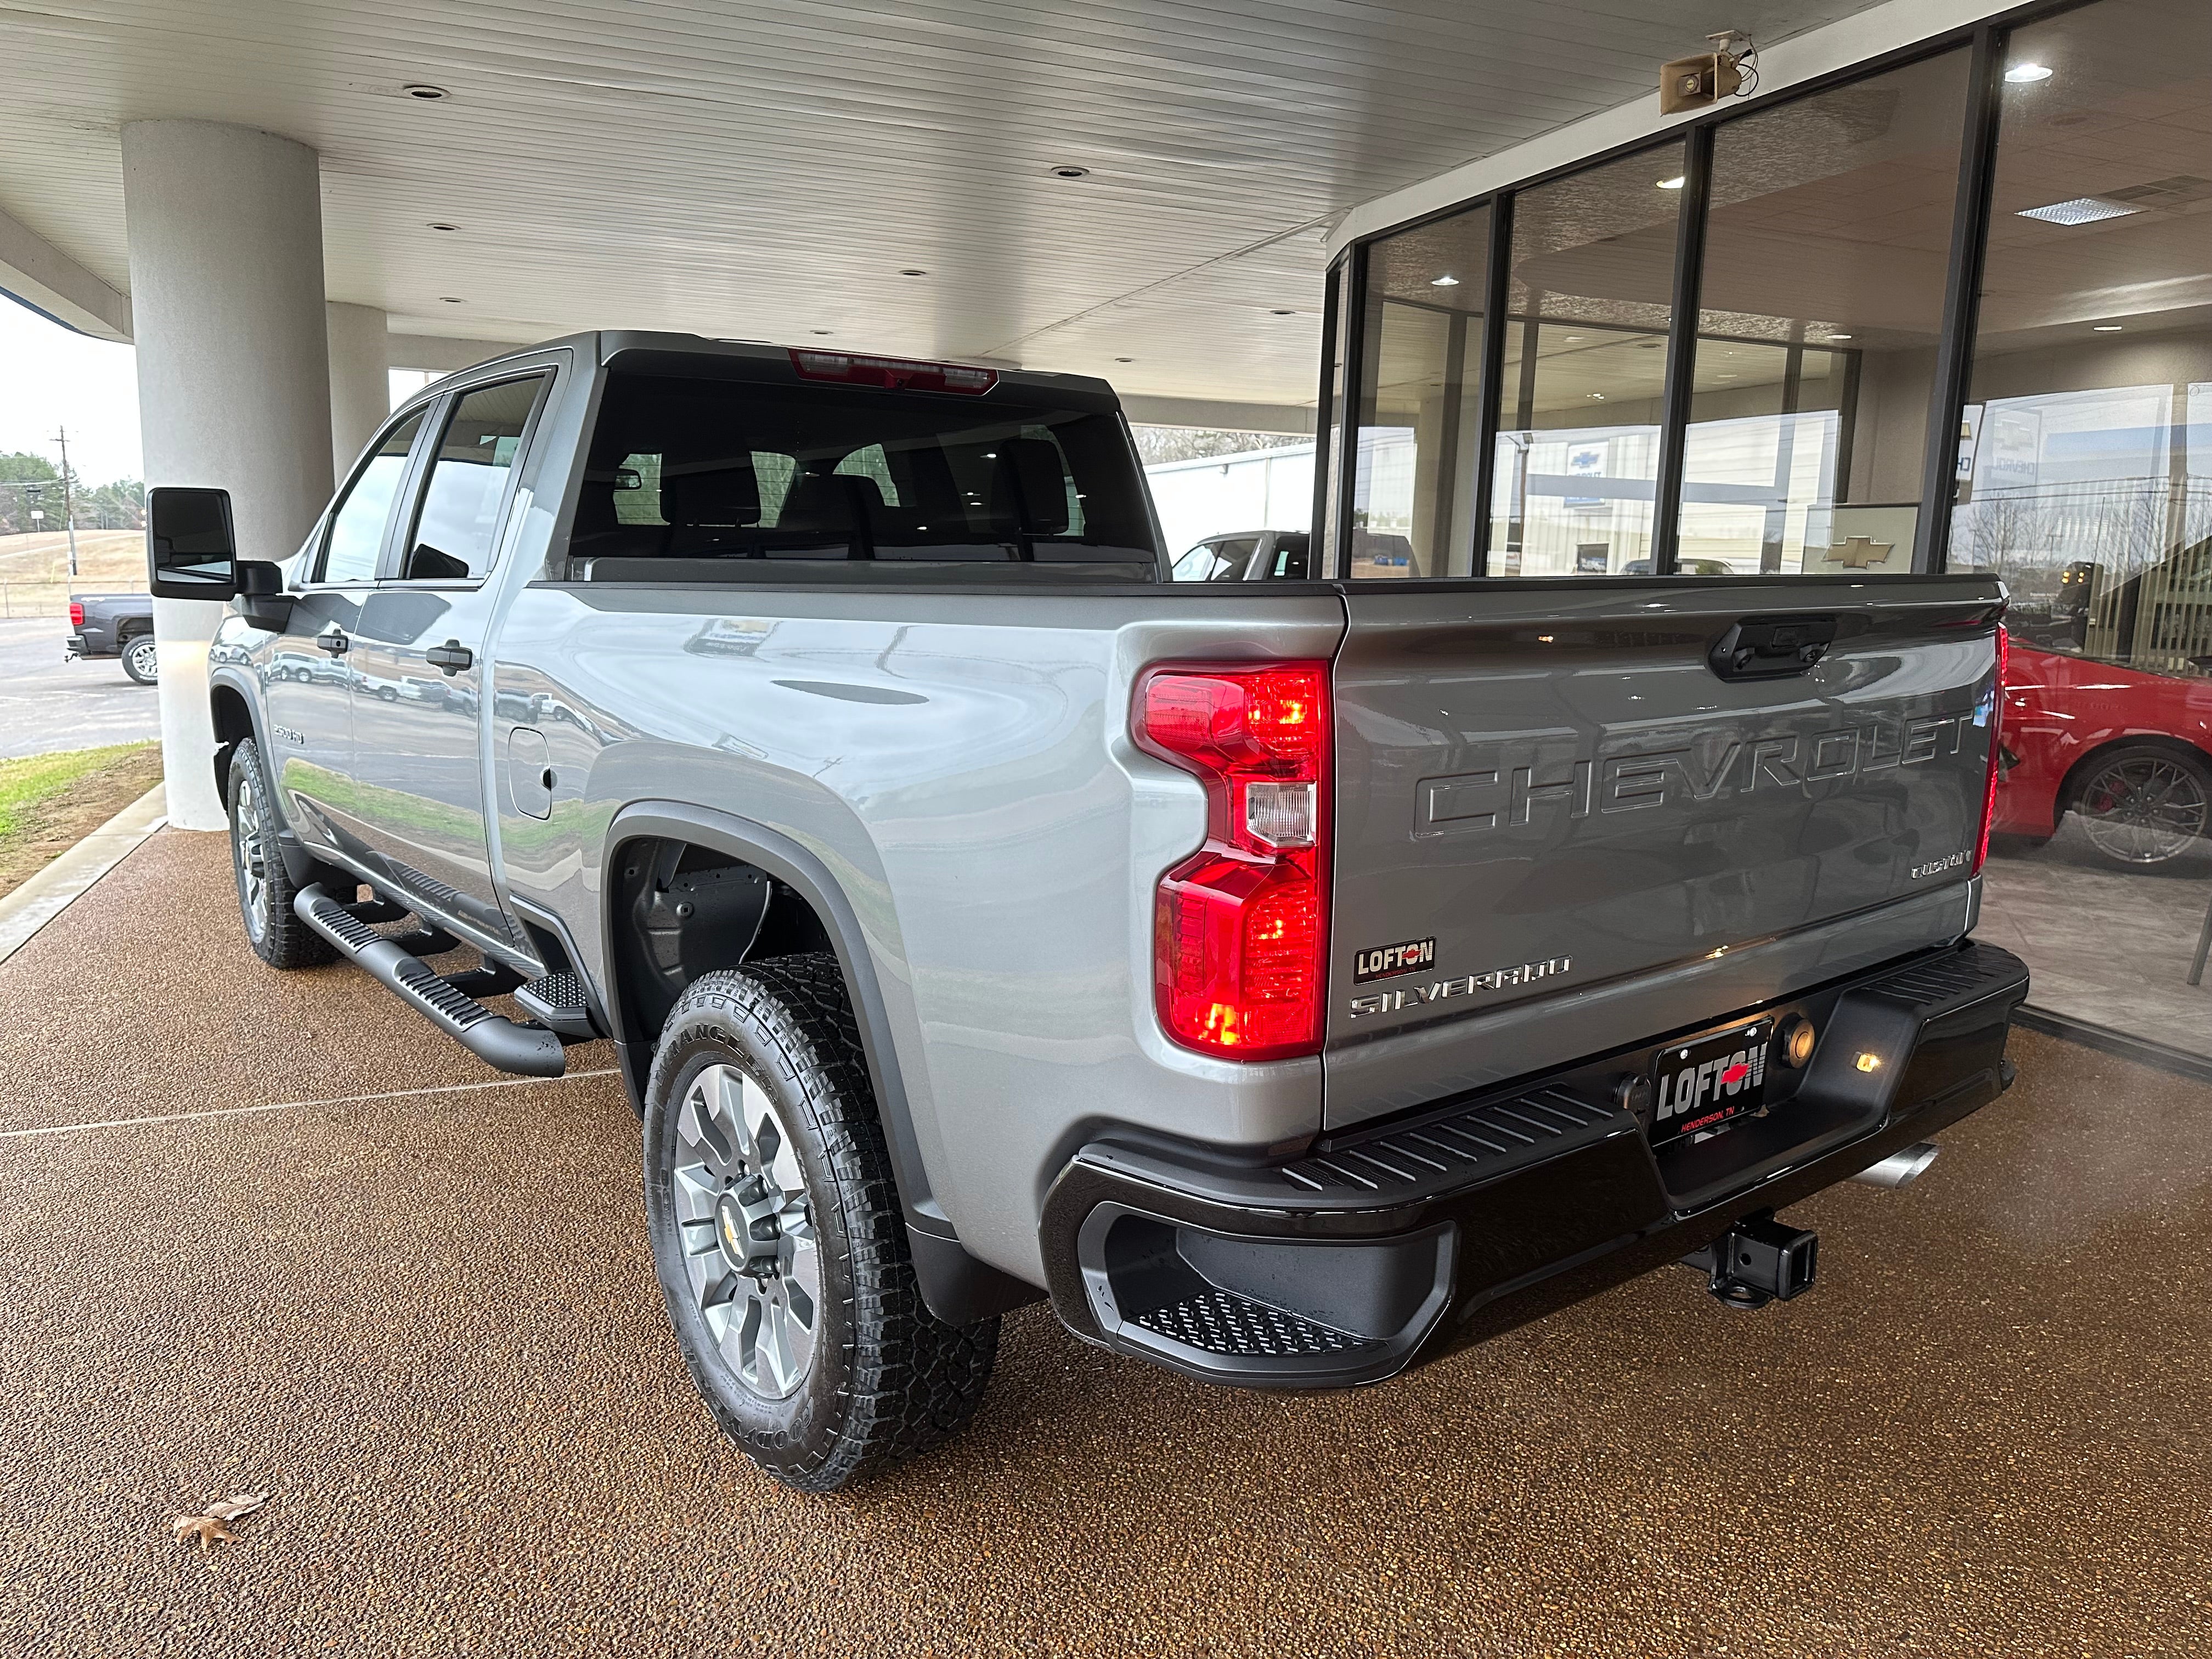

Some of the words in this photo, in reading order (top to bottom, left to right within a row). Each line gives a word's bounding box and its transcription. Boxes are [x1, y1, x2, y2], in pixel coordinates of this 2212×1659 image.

[1413, 708, 1973, 839] CHEVROLET
[1350, 955, 1573, 1019] SILVERADO
[1357, 940, 1434, 975] LOFTON
[656, 1024, 779, 1107] WRANGLER
[1657, 1042, 1768, 1121] LOFTON
[1726, 1107, 1734, 1116] TN
[681, 1336, 815, 1449] GOODYEAR
